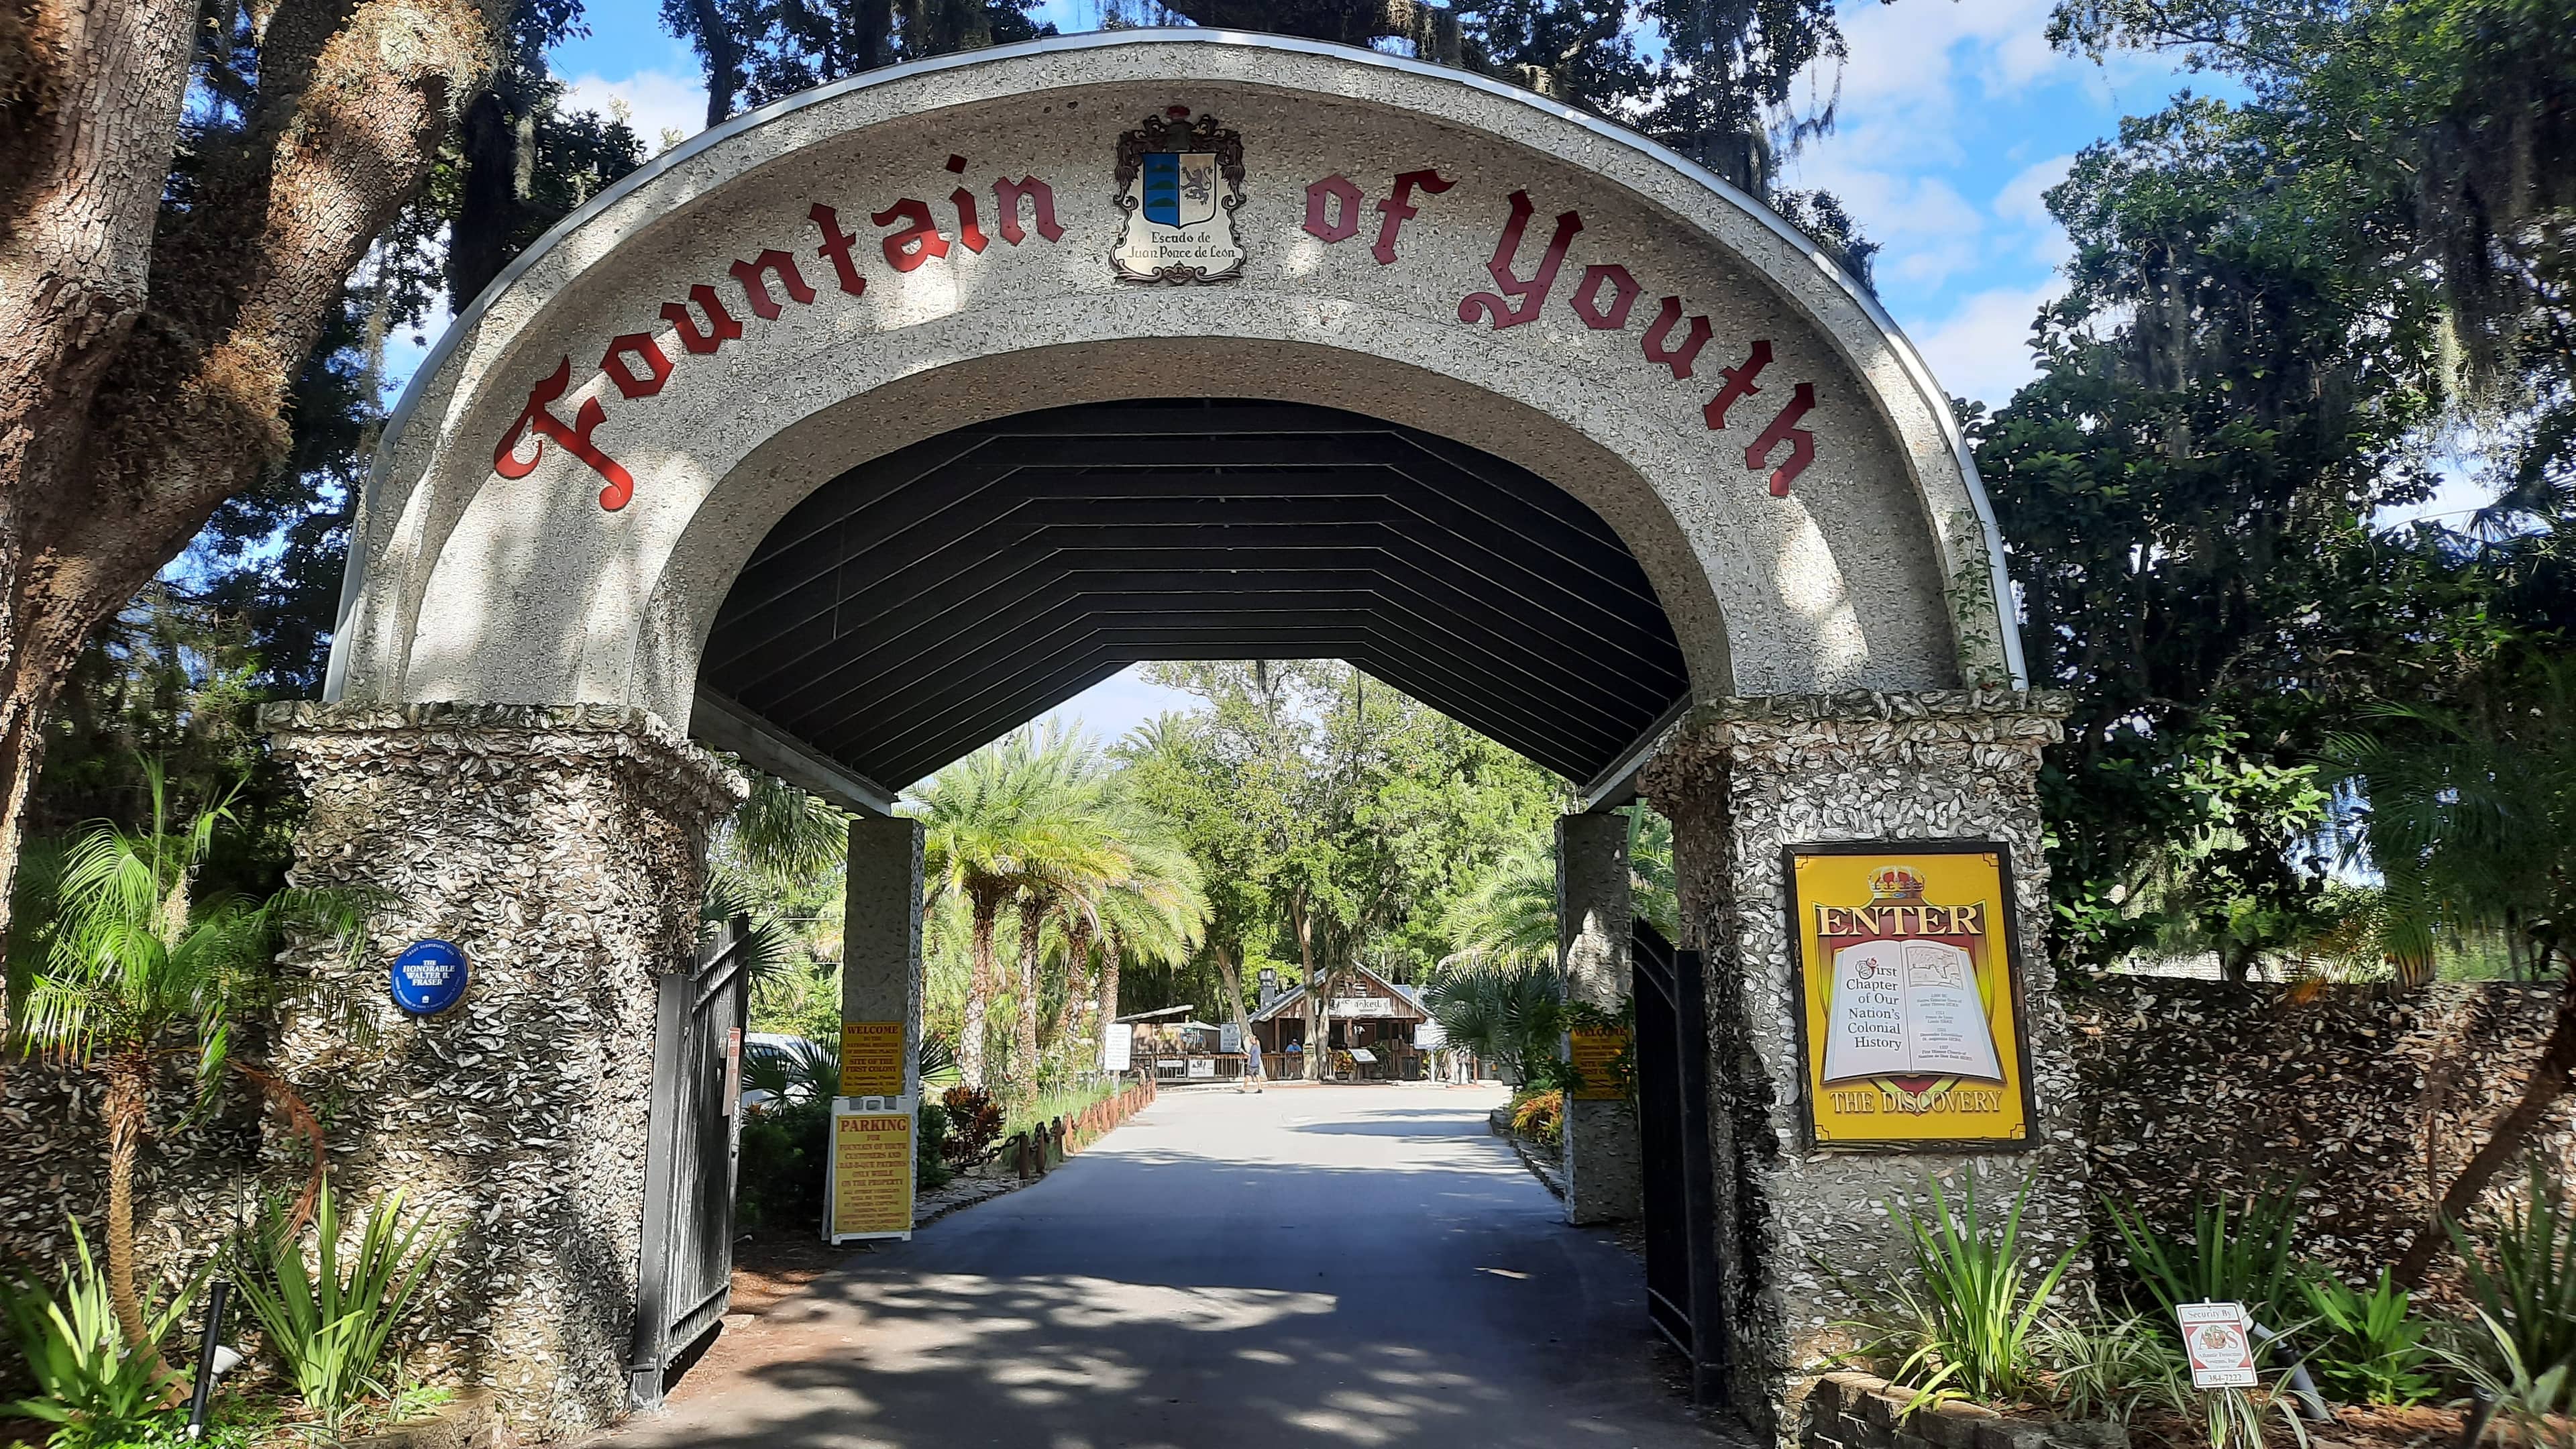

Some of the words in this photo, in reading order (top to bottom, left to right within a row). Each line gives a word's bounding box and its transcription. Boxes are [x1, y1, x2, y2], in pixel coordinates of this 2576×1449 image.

[1151, 231, 1193, 243] Escudo
[1197, 231, 1211, 243] de
[1127, 246, 1158, 258] Juan
[1159, 246, 1192, 258] Ponce
[1194, 246, 1208, 258] de
[494, 154, 1065, 511] Fountain
[1303, 168, 1458, 266] of
[1458, 189, 1816, 496] Youth
[1815, 905, 1983, 936] ENTER
[1855, 957, 1898, 980] First
[1846, 978, 1898, 991] Chapter
[1858, 992, 1871, 1004] of
[1874, 993, 1900, 1005] Our
[1849, 1007, 1900, 1020] Nation's
[847, 1026, 899, 1034] WELCOME
[1847, 1021, 1901, 1034] Colonial
[1854, 1036, 1902, 1051] History
[1829, 1090, 1874, 1114] THE
[1880, 1089, 2003, 1115] DISCOVERY
[841, 1119, 907, 1132] PARKING
[2188, 1310, 2220, 1320] Security
[2222, 1309, 2232, 1319] By
